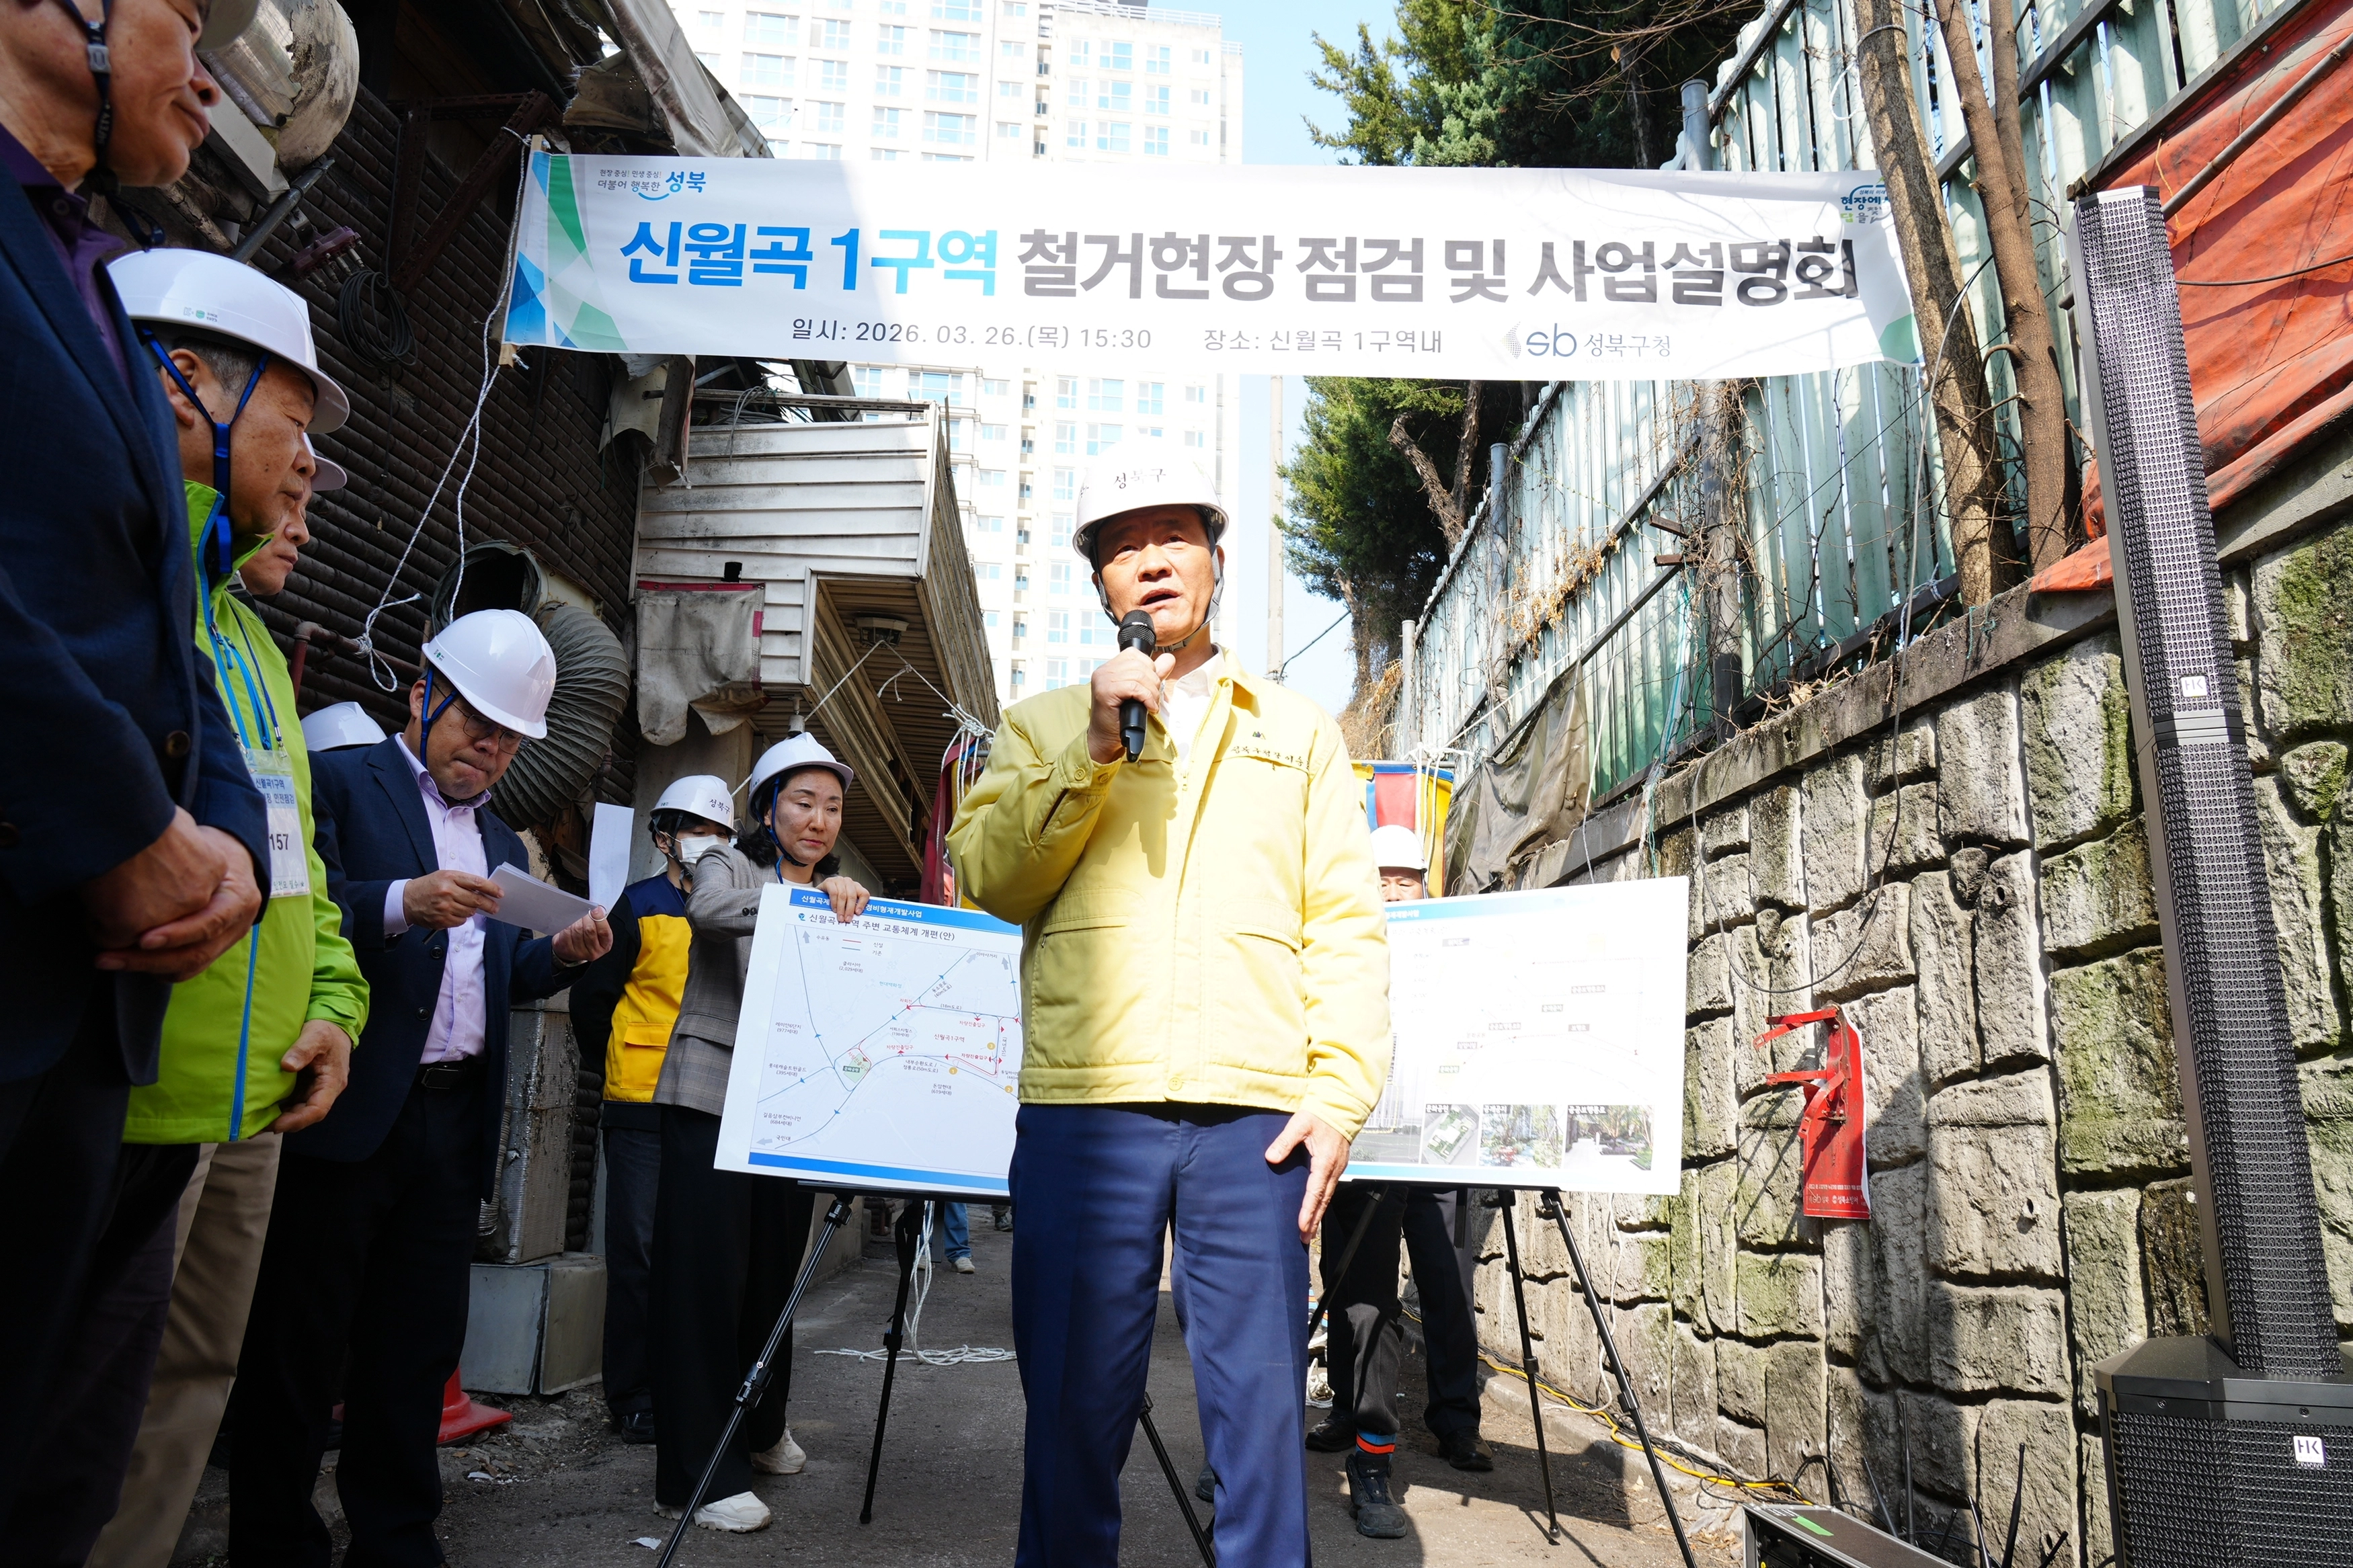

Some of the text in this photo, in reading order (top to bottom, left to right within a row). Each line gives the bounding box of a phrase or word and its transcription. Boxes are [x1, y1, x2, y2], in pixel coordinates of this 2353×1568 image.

[598, 171, 707, 194] 더불어 행복한 성북
[1840, 212, 1869, 224] 답을
[619, 221, 1859, 307] 신월곡 1구역 철거현장 점검 및 사업설명회
[792, 318, 1152, 349] 일시: 2026. 03. 26.(목) 15:30
[1203, 329, 1260, 352] 장소:
[1526, 323, 1577, 357] sb
[1584, 333, 1671, 358] 성북구청
[1113, 468, 1166, 489] 성북구
[2184, 678, 2203, 690] HK
[255, 778, 285, 790] 신월곡1구역
[274, 793, 294, 804] 안전점검
[709, 798, 730, 814] 성북구
[269, 833, 289, 850] 157
[865, 903, 922, 918] 정비형재개발사업
[809, 913, 955, 941] 신월곡역 주변 교통체계 개편(안)
[934, 1033, 965, 1043] 신월곡1구역
[2297, 1439, 2320, 1454] HK
